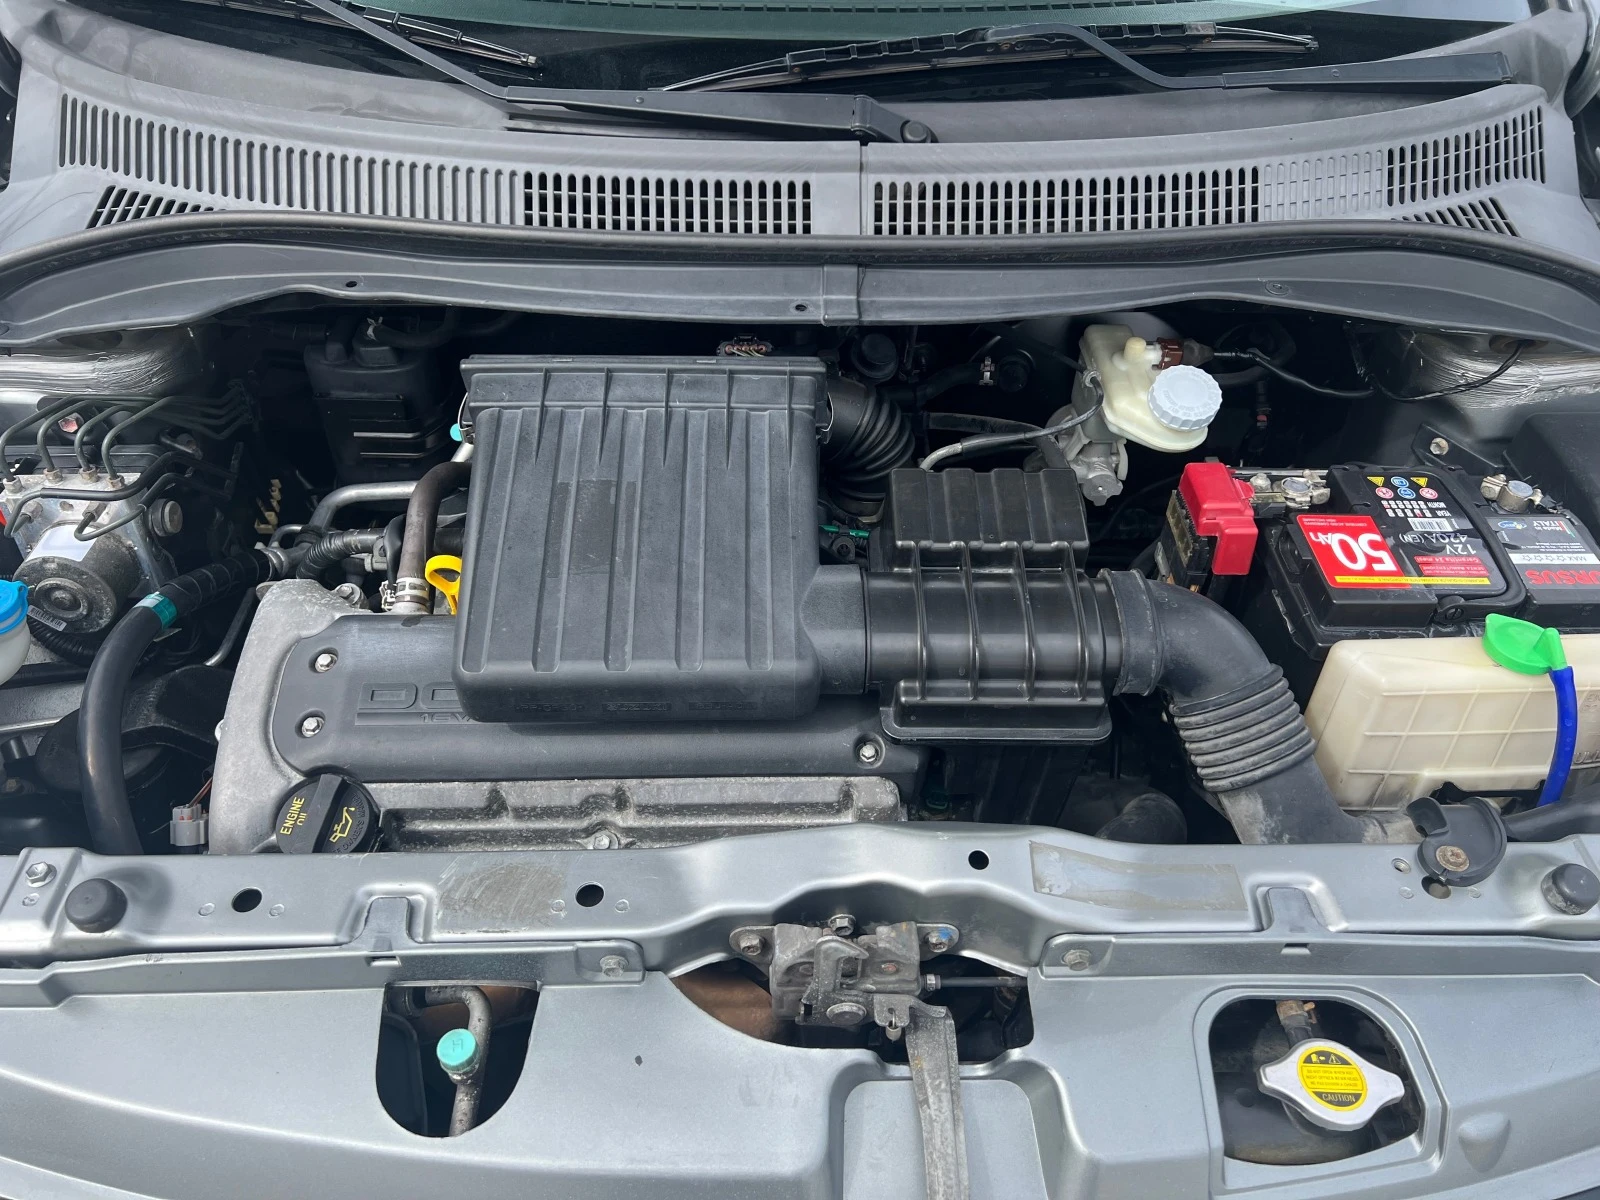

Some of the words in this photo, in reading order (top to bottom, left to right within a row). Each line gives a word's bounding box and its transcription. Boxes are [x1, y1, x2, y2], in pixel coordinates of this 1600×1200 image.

[1399, 533, 1424, 543] (EN)
[1446, 544, 1477, 554] 12V
[280, 796, 305, 835] ENGINE
[1322, 1093, 1356, 1102] CAUTION
